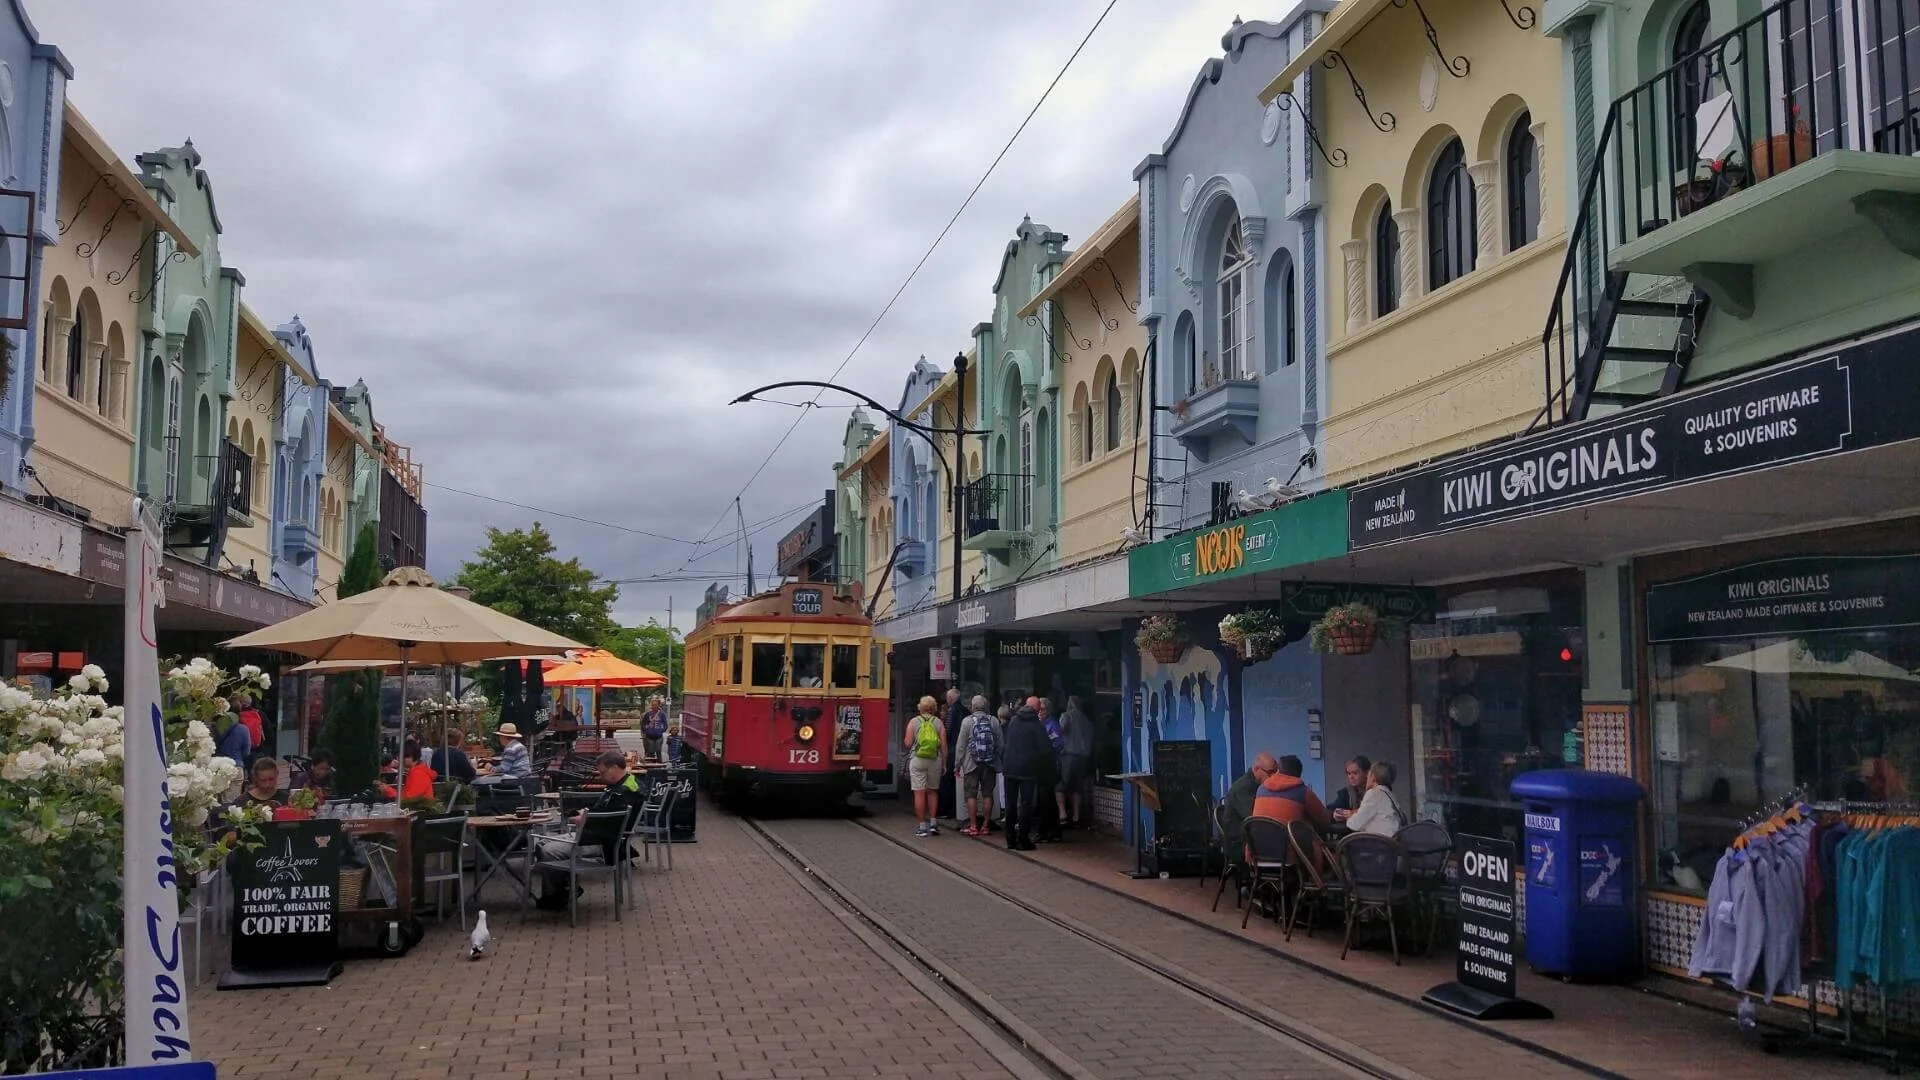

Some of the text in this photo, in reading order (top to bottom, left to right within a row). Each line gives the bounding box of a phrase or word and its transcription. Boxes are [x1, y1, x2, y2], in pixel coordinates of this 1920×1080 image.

[1685, 386, 1819, 435] QUALITY GIFTWARE
[1704, 418, 1798, 455] & SOUVENIRS
[1443, 428, 1657, 514] KIWI ORIGINALS
[1375, 495, 1396, 512] MADE
[1366, 509, 1415, 531] NEW ZEALAND
[1182, 524, 1266, 576] THE NOOK EATERY
[795, 592, 820, 602] CITY
[1728, 574, 1830, 598] KIWI ORIGINALS
[793, 603, 822, 612] TOUR
[1688, 596, 1885, 622] NEW ZEALAND MADE GIFTWARE & SOUVENIRS
[1000, 641, 1054, 656] Institution
[788, 749, 820, 764] 178
[1527, 815, 1556, 829] MAILBOX
[255, 855, 318, 872] Coffee Lovers
[1464, 850, 1508, 883] OPEN
[242, 886, 331, 902] 100% FAIR
[1461, 892, 1511, 914] KIWI ORIGINALS
[242, 902, 331, 914] TRADE, ORGANIC
[241, 914, 331, 936] COFFEE
[1464, 922, 1509, 944] NEW ZEALAND
[1460, 940, 1512, 965] MADE GIFTWARE
[1464, 960, 1507, 983] & SOUVENIRS
